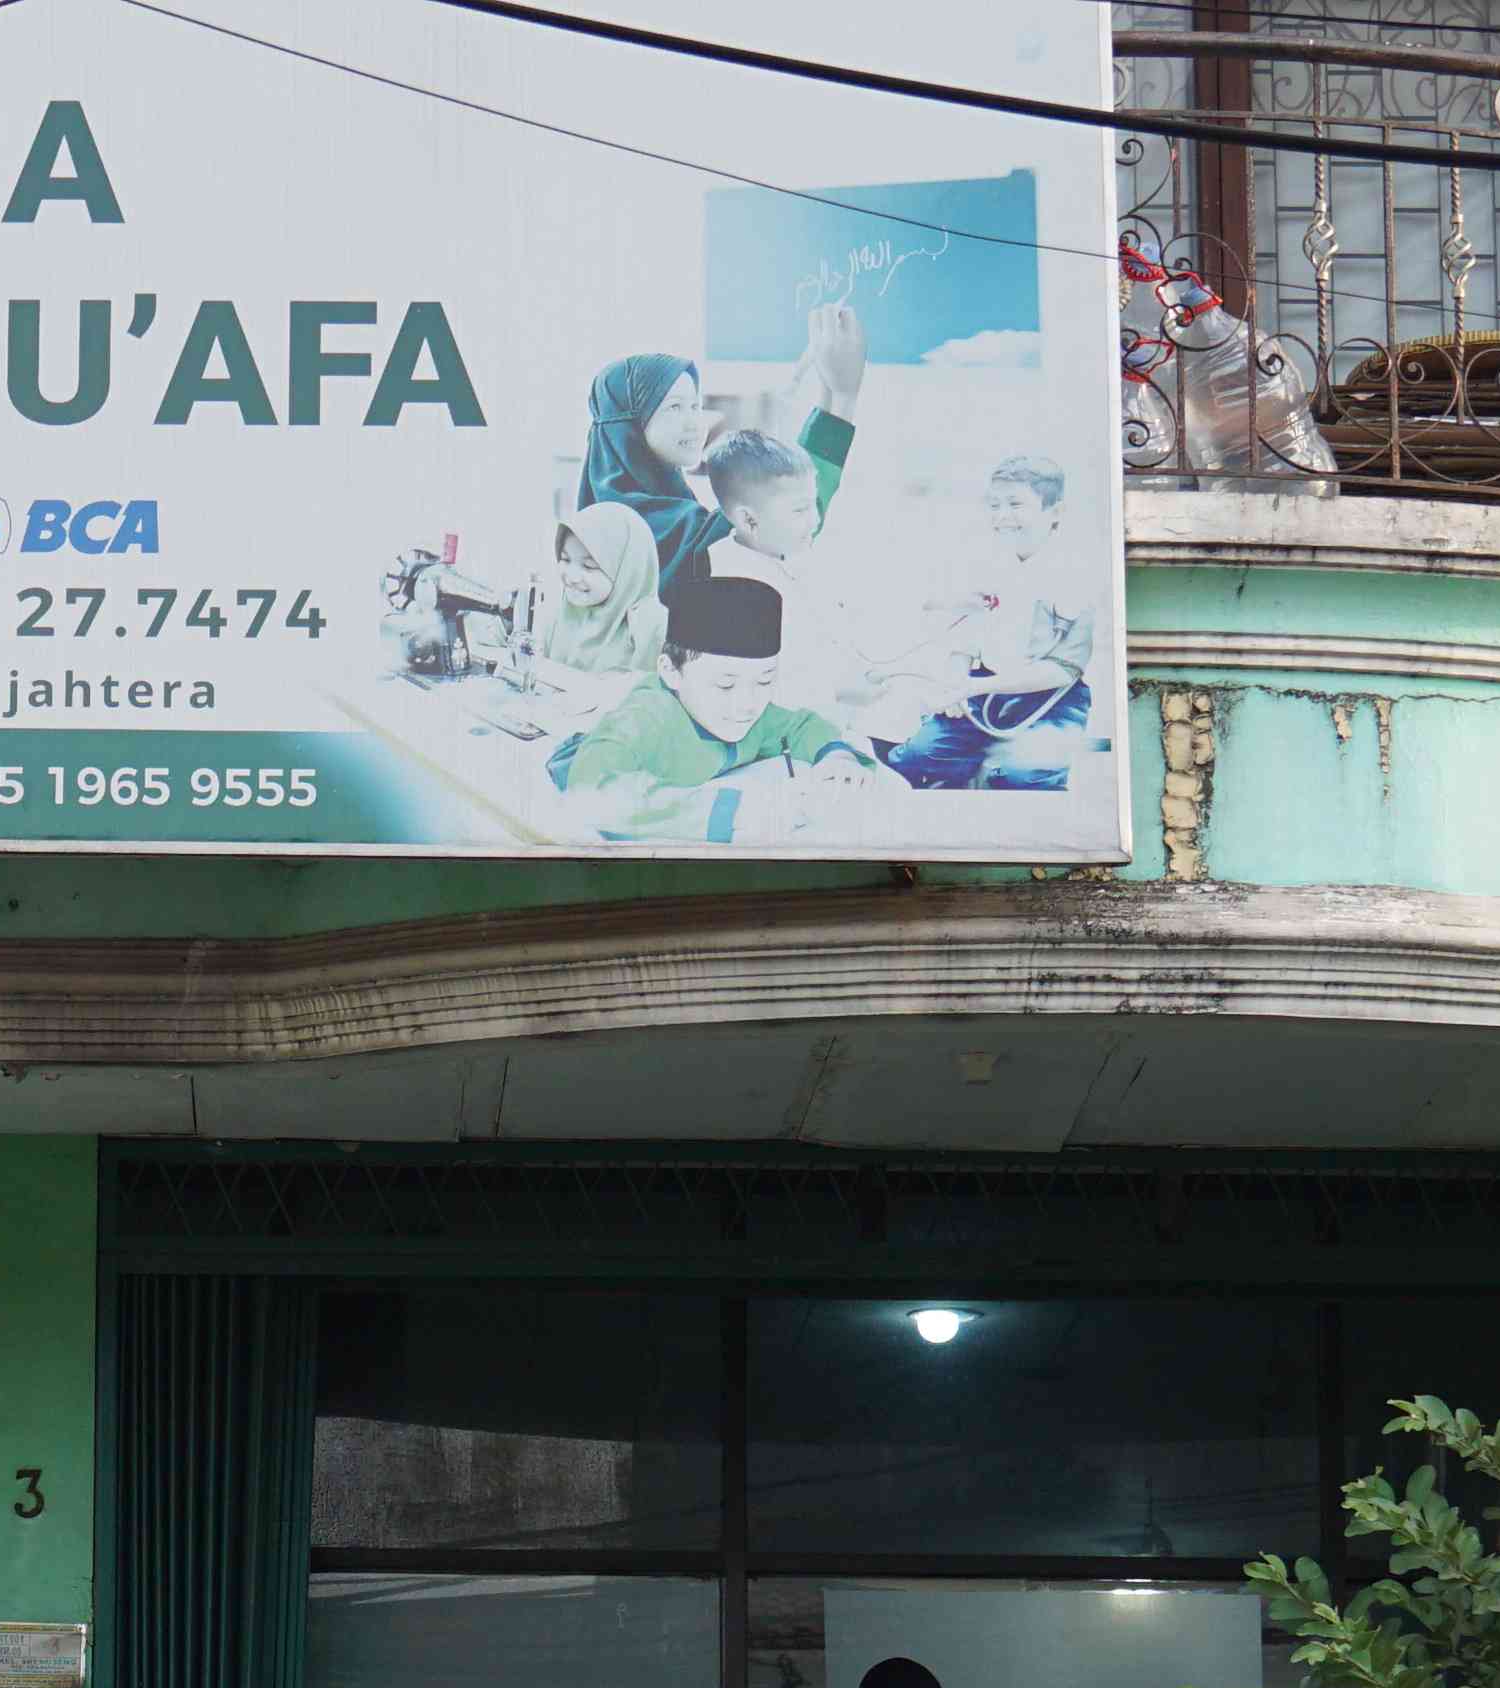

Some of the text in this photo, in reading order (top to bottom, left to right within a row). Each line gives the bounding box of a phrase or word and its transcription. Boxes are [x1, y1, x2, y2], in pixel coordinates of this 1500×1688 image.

[19, 499, 160, 554] BCA
[49, 767, 173, 806] 1965
[190, 768, 318, 808] 9555
[13, 1467, 45, 1519] 3
